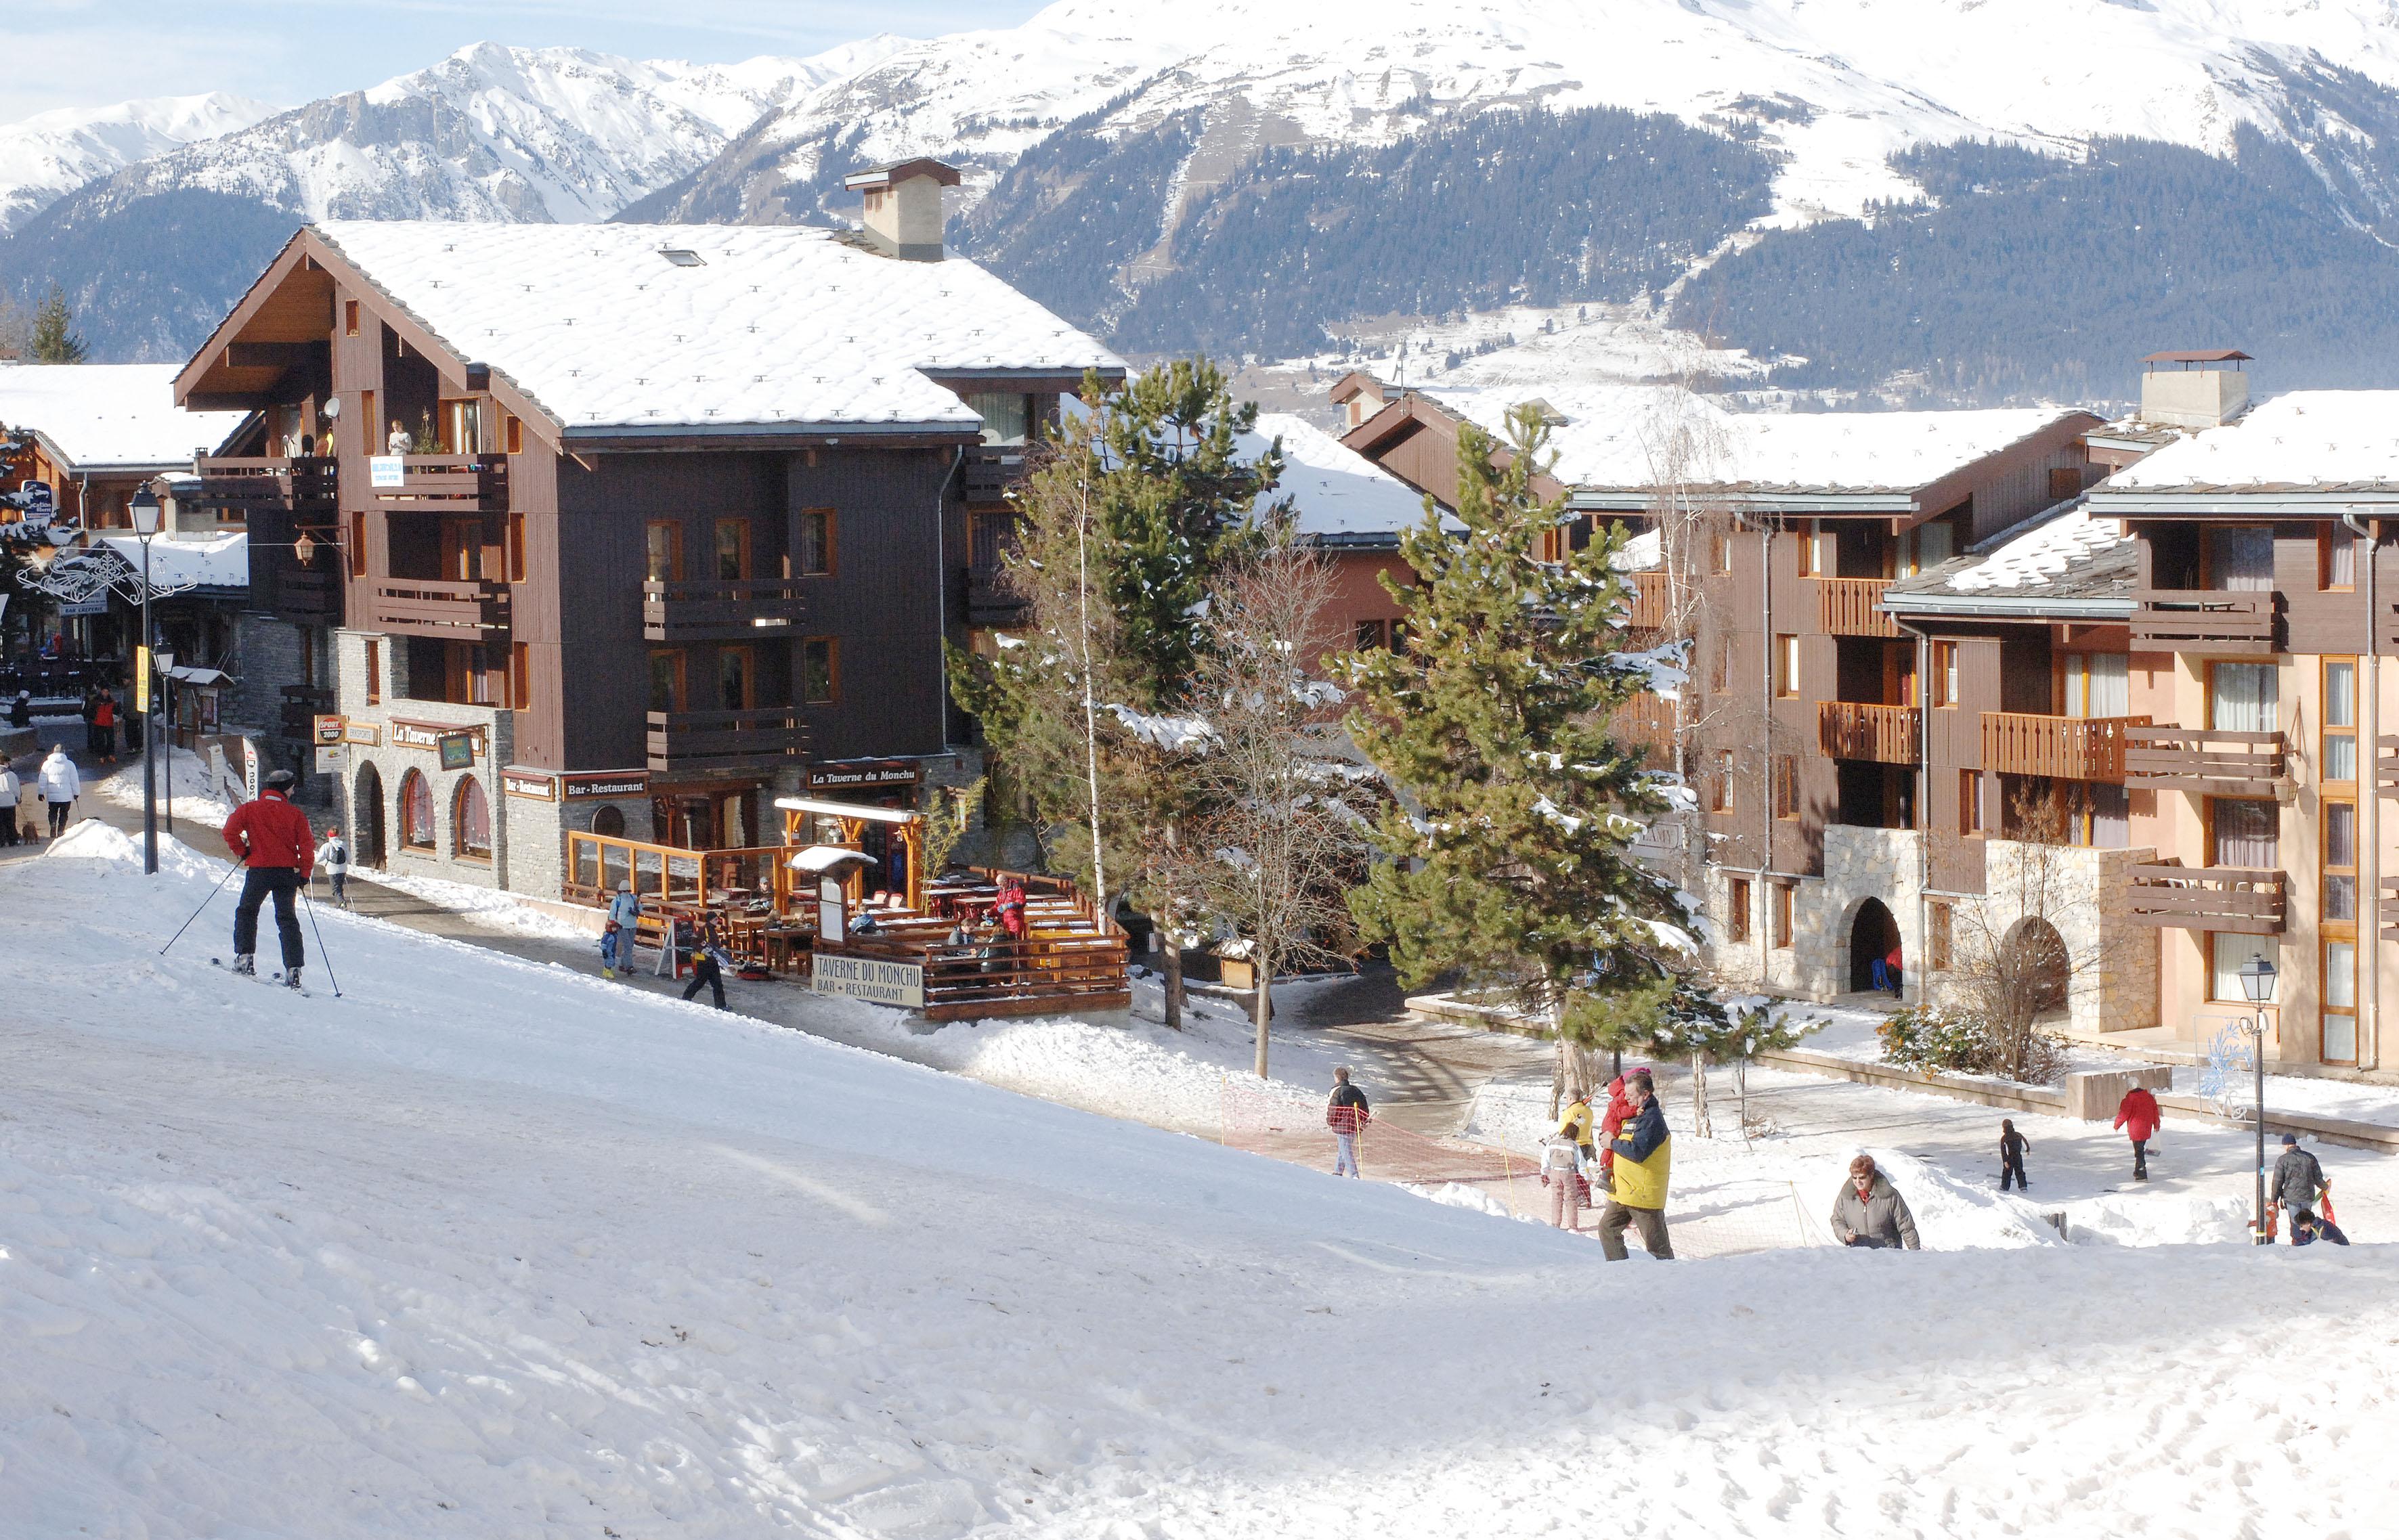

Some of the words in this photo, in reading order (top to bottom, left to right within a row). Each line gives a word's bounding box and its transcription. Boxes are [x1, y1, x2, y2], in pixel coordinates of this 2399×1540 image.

[393, 724, 404, 742] La
[404, 725, 436, 746] Taverne
[813, 774, 824, 784] La
[827, 774, 862, 783] Taverne
[865, 772, 877, 781] du
[880, 770, 915, 780] Monchu
[568, 785, 585, 795] Bar
[591, 783, 644, 793] Restaurant
[818, 957, 859, 980] TAVERNE
[862, 963, 874, 982] DU
[878, 965, 920, 987] MONCHU
[817, 979, 835, 992] BAR
[846, 982, 904, 1000] RESTAURANT
